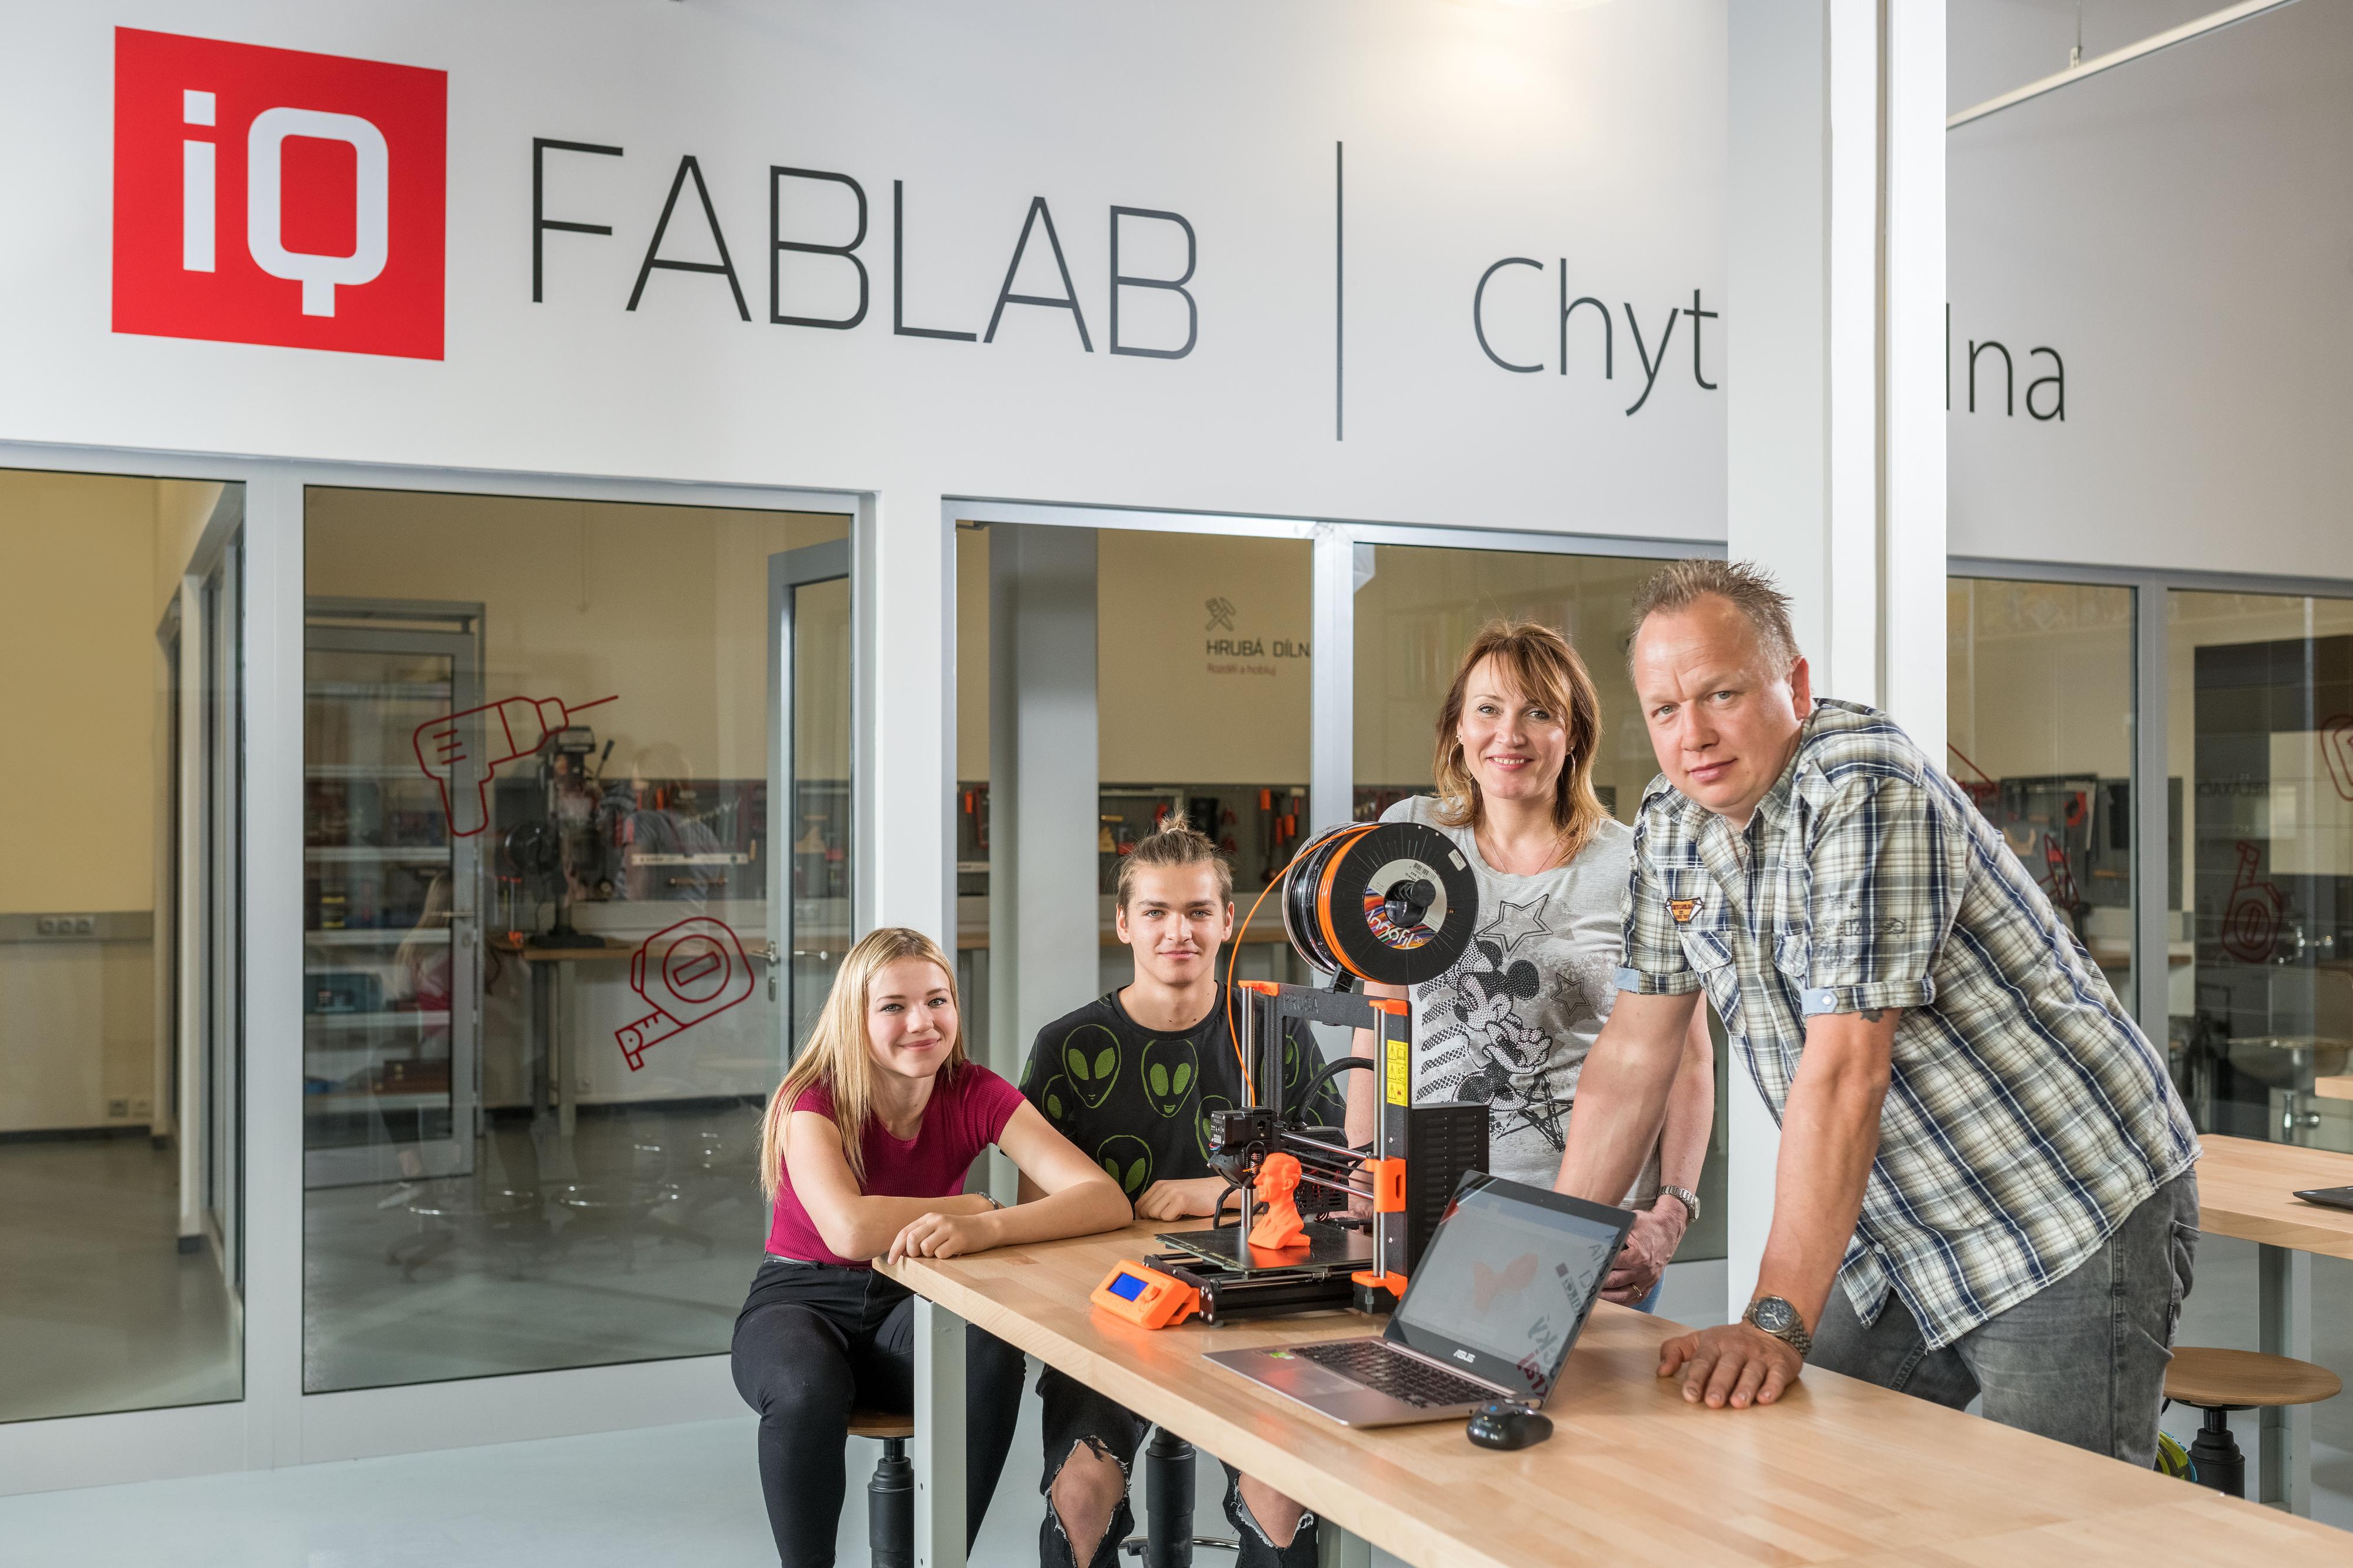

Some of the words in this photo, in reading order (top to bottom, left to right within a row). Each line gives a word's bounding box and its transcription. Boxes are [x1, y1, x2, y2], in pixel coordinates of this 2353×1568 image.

[183, 89, 389, 318] iQ
[532, 137, 1198, 360] FABLAB
[1473, 257, 1718, 416] Chyt
[1946, 303, 2065, 422] lna
[1207, 637, 1264, 657] HRUBÁ
[1272, 638, 1311, 658] DÍLN
[1405, 872, 1416, 881] Orange
[1367, 909, 1415, 949] Innofil
[1414, 936, 1423, 944] 3D
[1284, 992, 1318, 1014] PRUSA
[1453, 1349, 1476, 1363] ASUS
